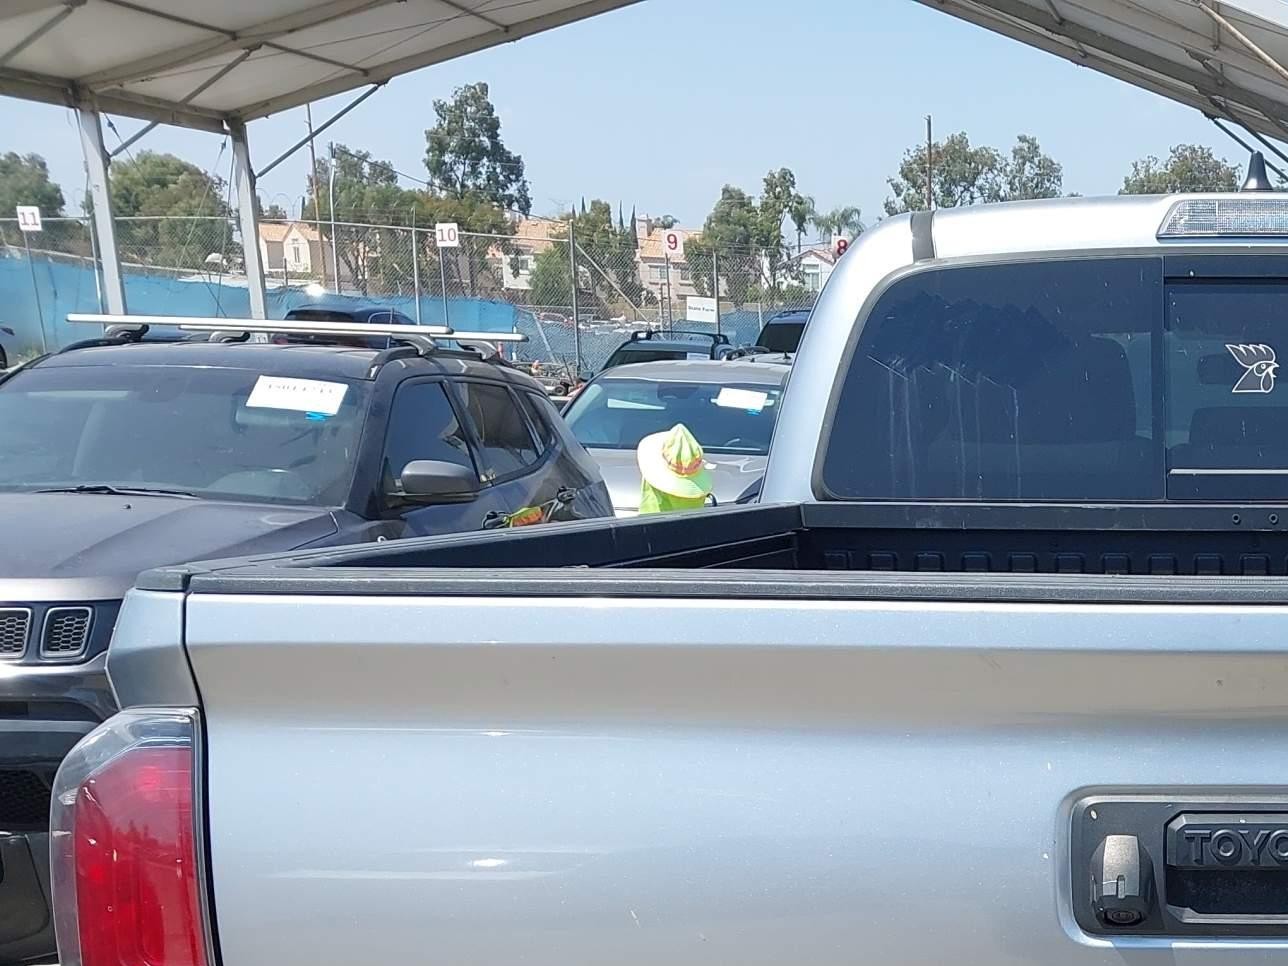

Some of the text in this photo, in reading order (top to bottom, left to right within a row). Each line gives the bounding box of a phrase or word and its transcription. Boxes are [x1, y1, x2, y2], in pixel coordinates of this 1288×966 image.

[20, 212, 39, 226] 11
[437, 227, 457, 242] 10
[666, 233, 678, 250] 9
[837, 239, 848, 256] 8
